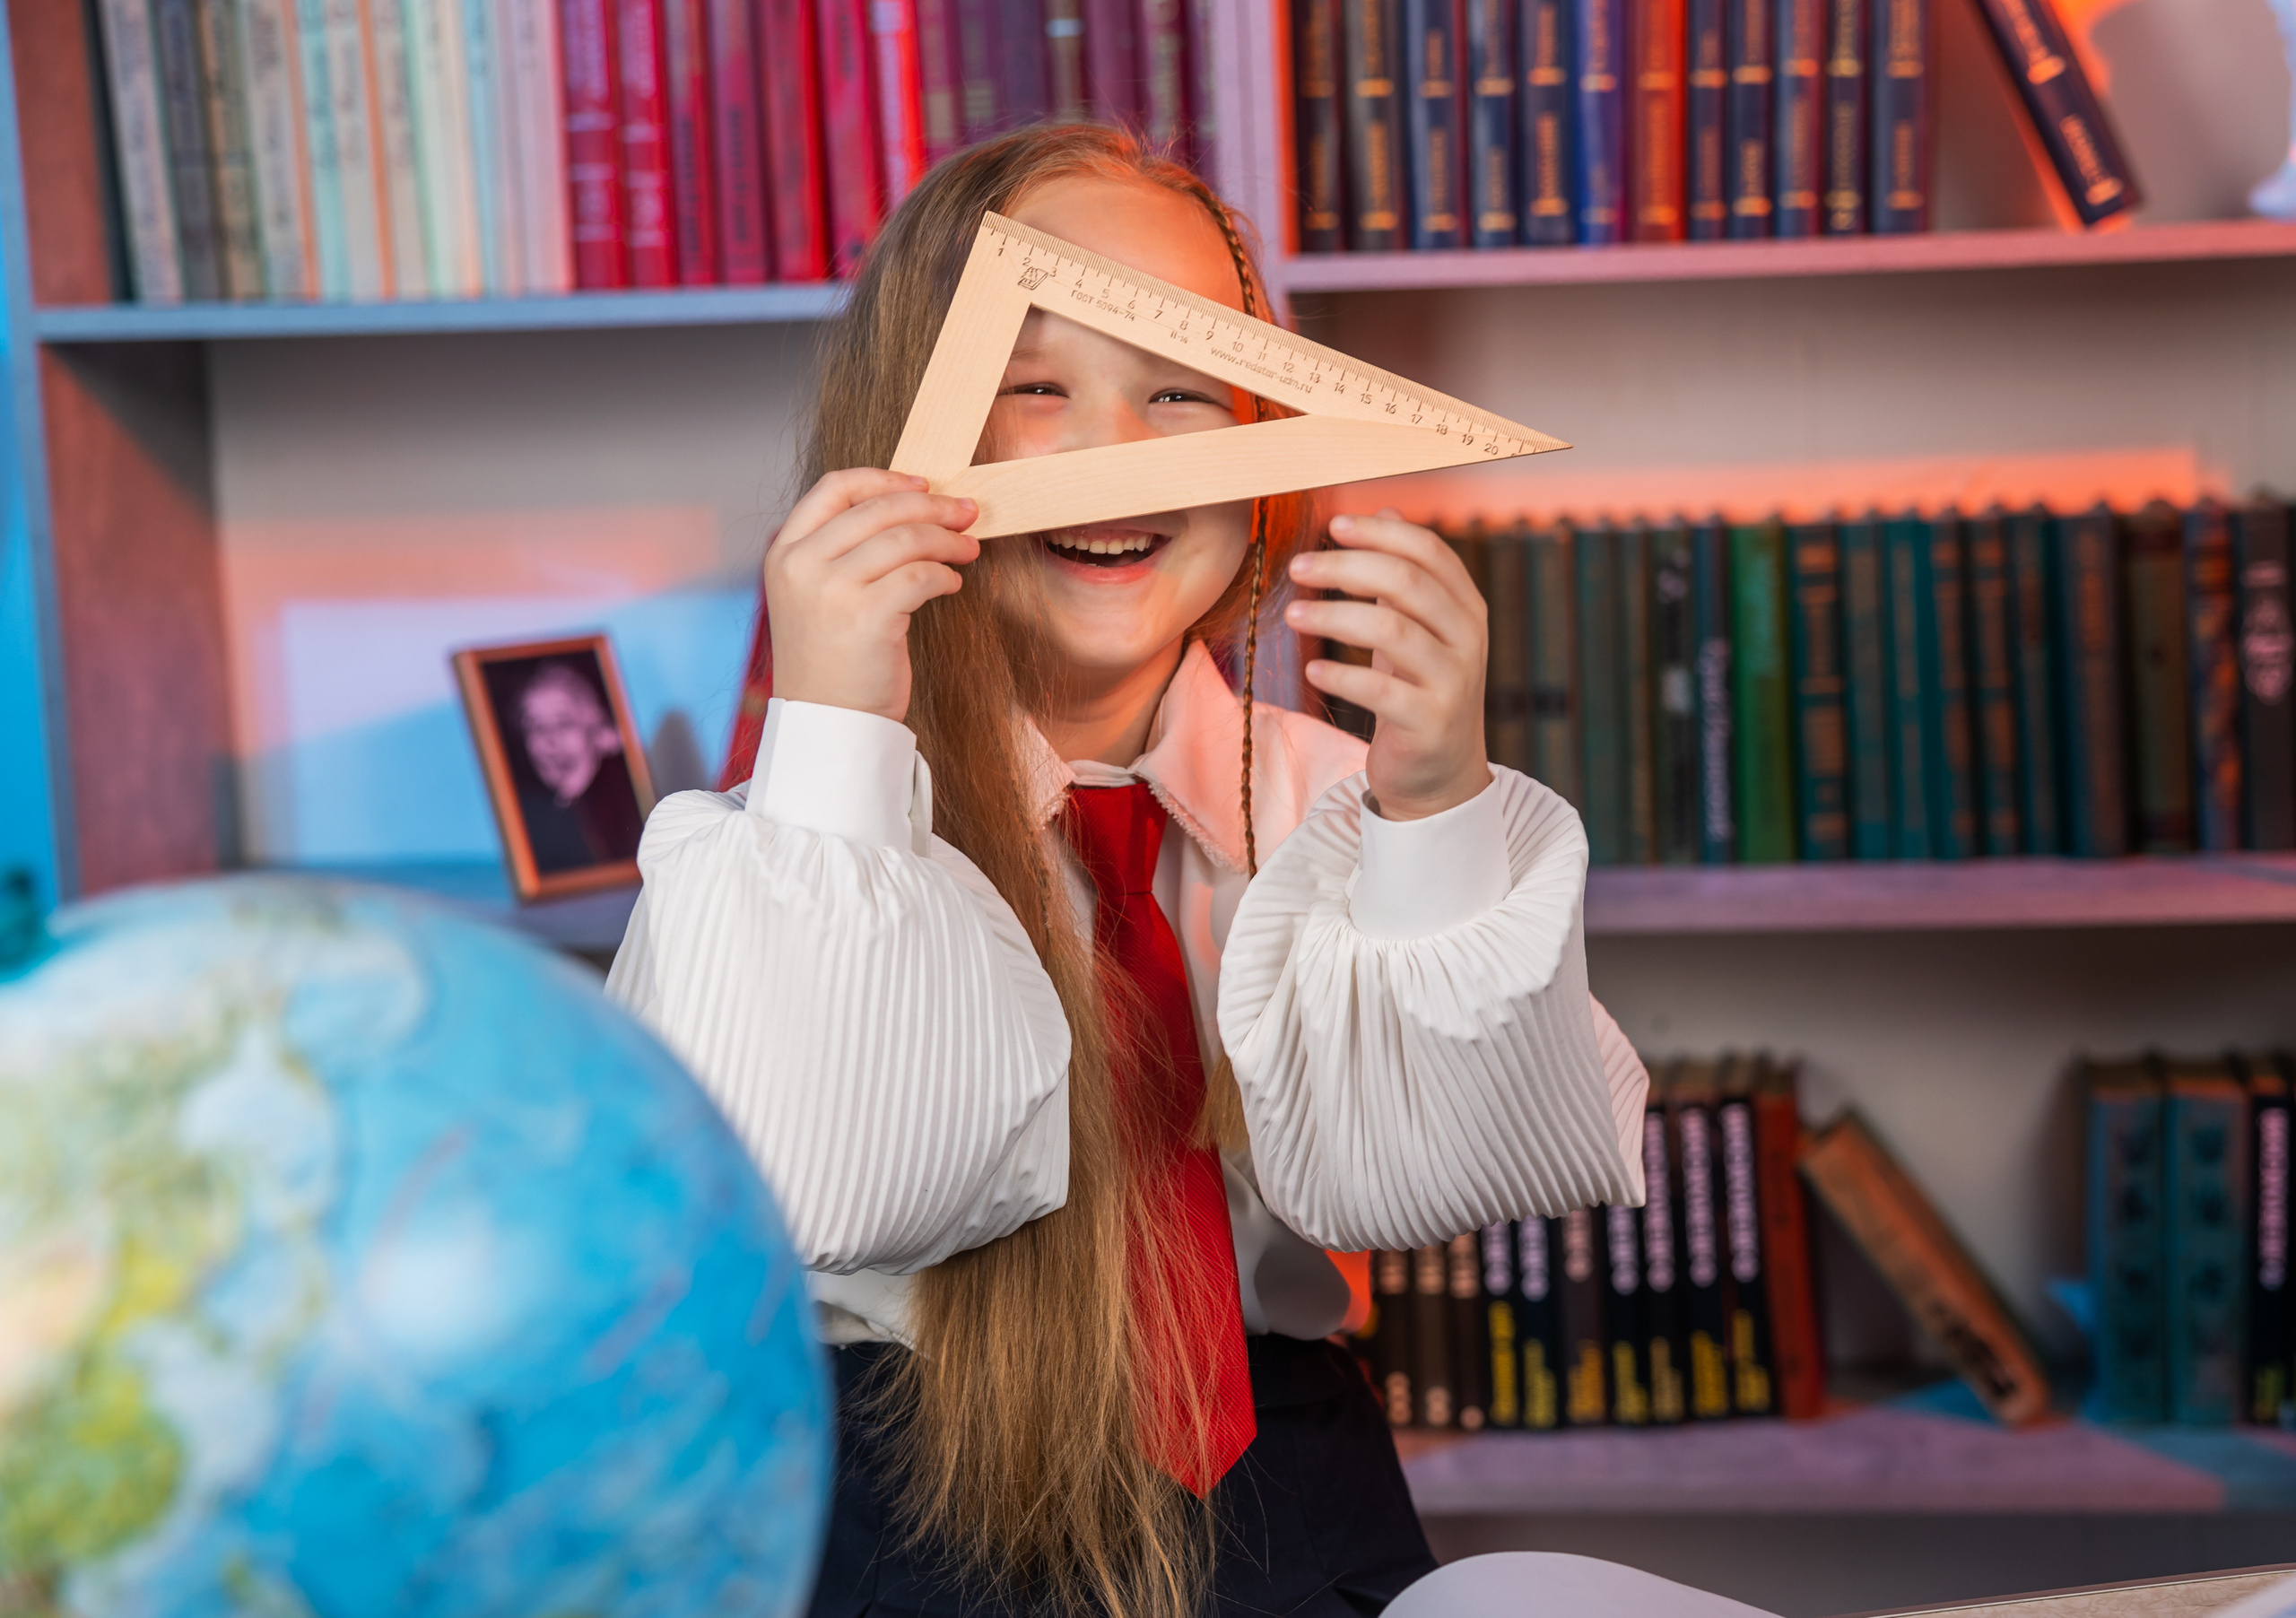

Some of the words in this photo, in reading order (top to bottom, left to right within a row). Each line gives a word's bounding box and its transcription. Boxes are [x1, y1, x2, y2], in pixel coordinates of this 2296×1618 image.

[997, 248, 1004, 257] 1
[1022, 257, 1031, 266] 2
[1049, 266, 1057, 277] 3
[1075, 279, 1083, 288] 4
[1101, 288, 1109, 299] 5
[1127, 300, 1136, 309] 6
[1154, 309, 1163, 319] 7
[1179, 320, 1188, 331] 8
[1205, 330, 1214, 341] 9
[1232, 341, 1244, 352] 10
[1257, 352, 1267, 361] 11
[1283, 361, 1294, 373] 12
[1309, 372, 1321, 384] 13
[1334, 382, 1345, 394] 14
[1360, 393, 1372, 404] 15
[1385, 403, 1396, 414] 16
[1411, 413, 1423, 424] 17
[1436, 423, 1448, 435] 18
[1461, 434, 1474, 446] 19
[1483, 443, 1499, 456] 20
[1071, 290, 1094, 304] ГОСТ
